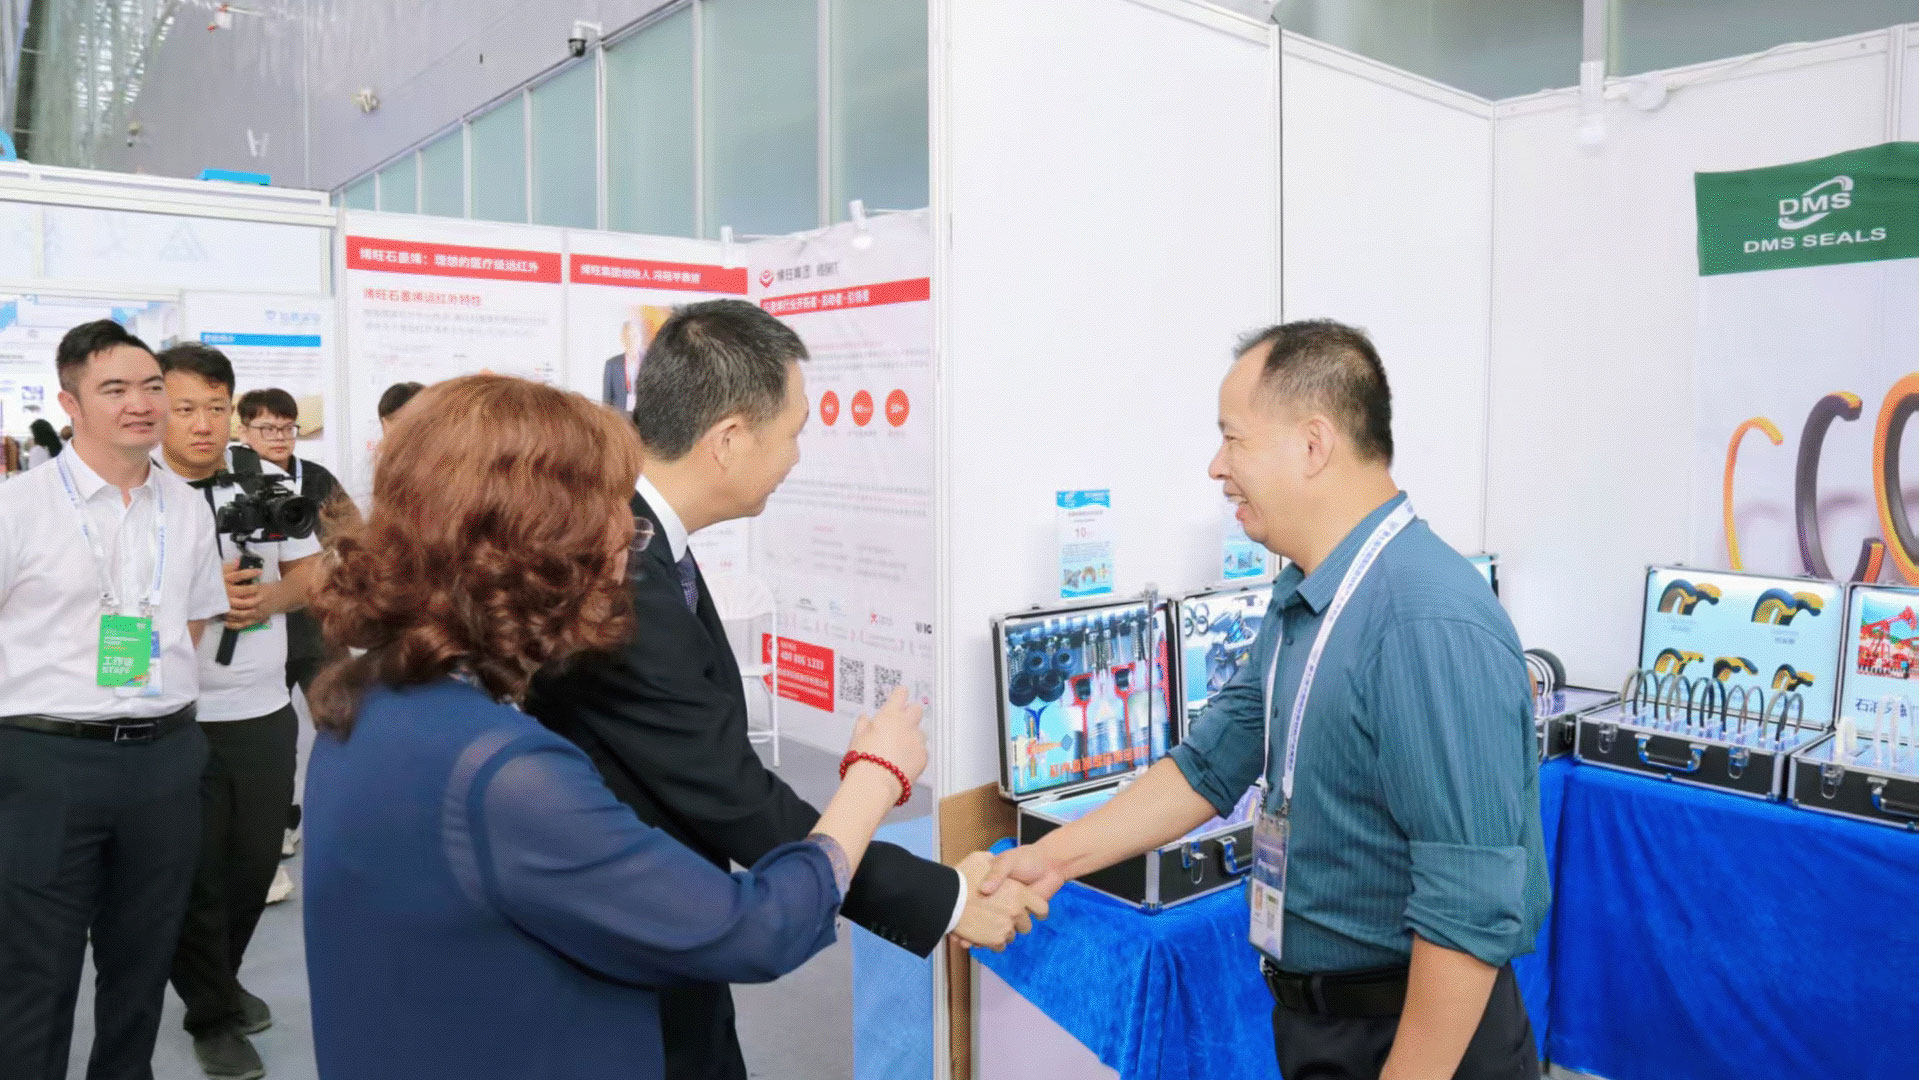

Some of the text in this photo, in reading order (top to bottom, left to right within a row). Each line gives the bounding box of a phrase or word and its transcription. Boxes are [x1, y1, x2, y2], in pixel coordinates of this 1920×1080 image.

[1779, 192, 1852, 216] DMS
[1743, 227, 1887, 254] DMS SEALS
